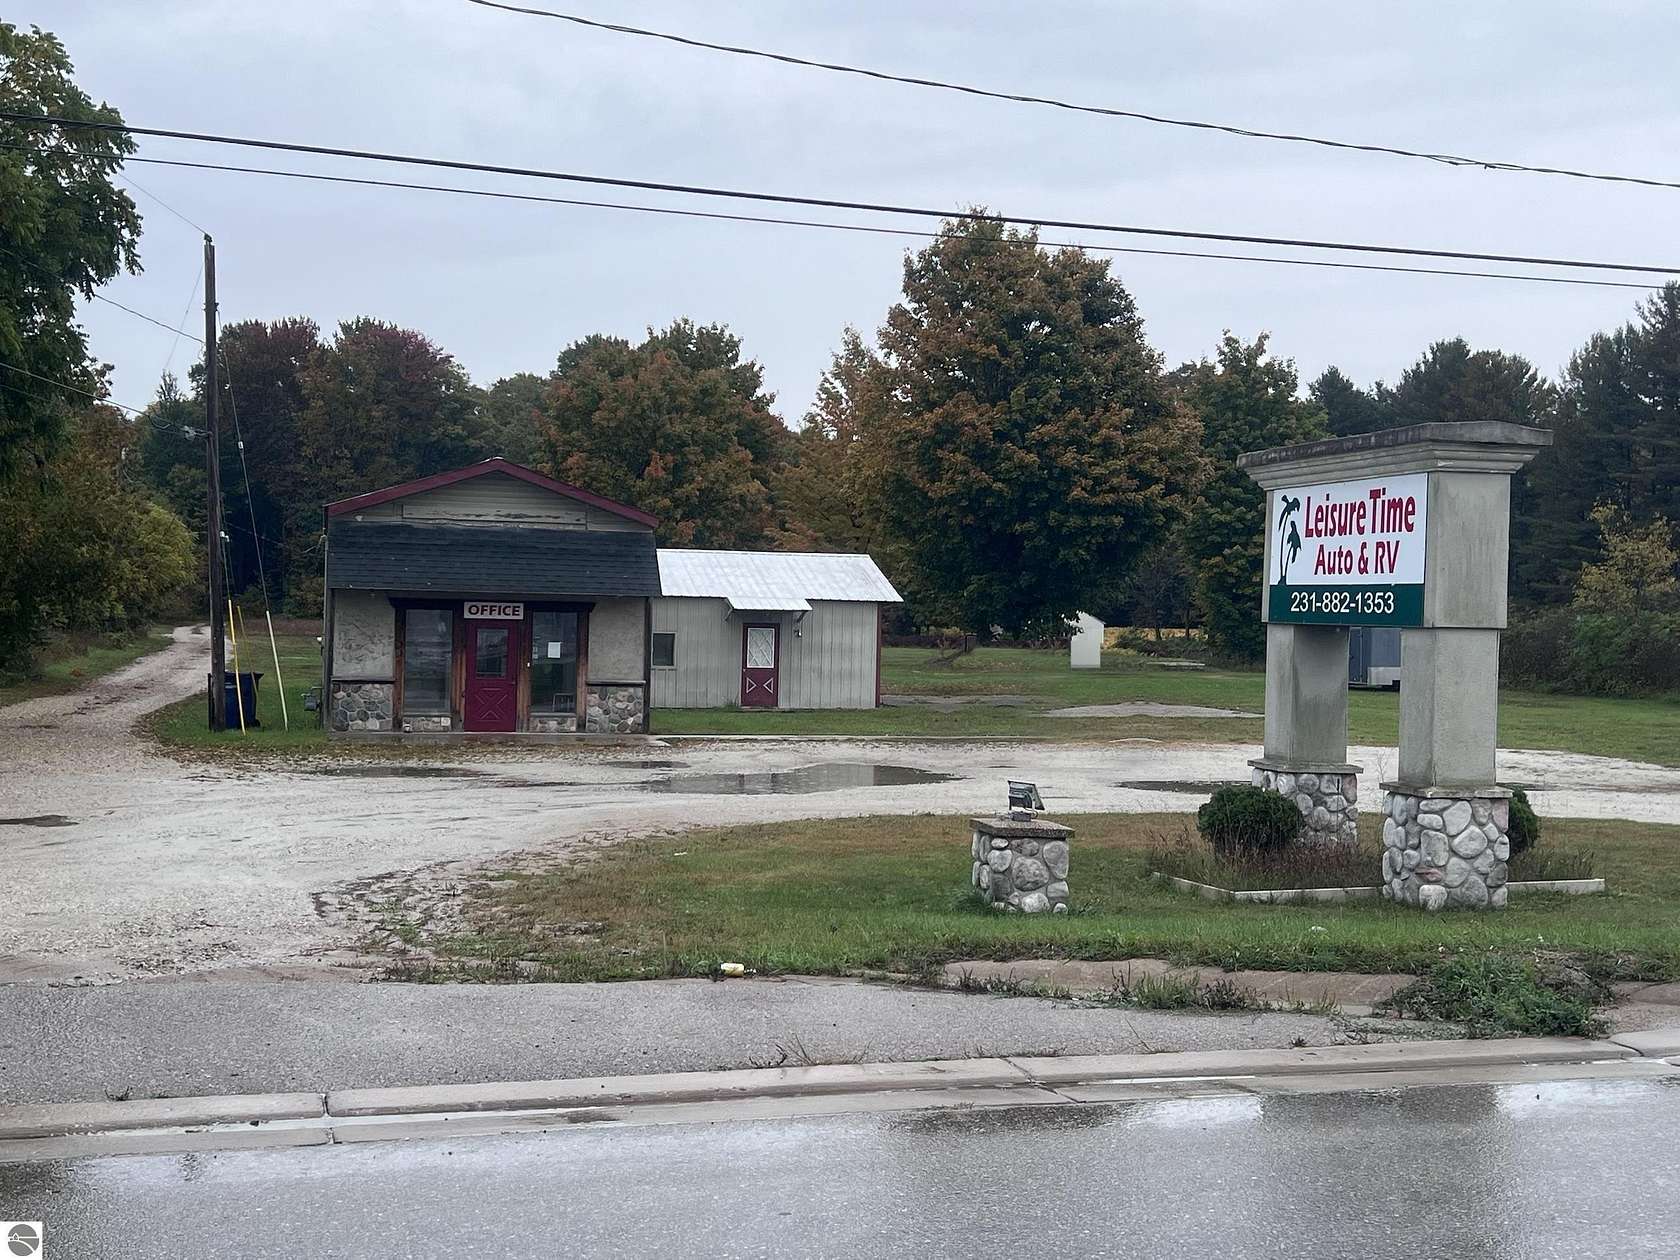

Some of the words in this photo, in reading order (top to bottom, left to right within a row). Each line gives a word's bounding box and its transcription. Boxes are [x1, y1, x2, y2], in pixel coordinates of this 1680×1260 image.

[1304, 493, 1367, 538] Leisure
[1369, 487, 1416, 534] Time
[1314, 544, 1354, 575] Auto
[1358, 541, 1369, 575] &
[1374, 540, 1400, 574] RV
[468, 604, 521, 616] OFFICE
[1290, 591, 1395, 614] 231-882-1353
